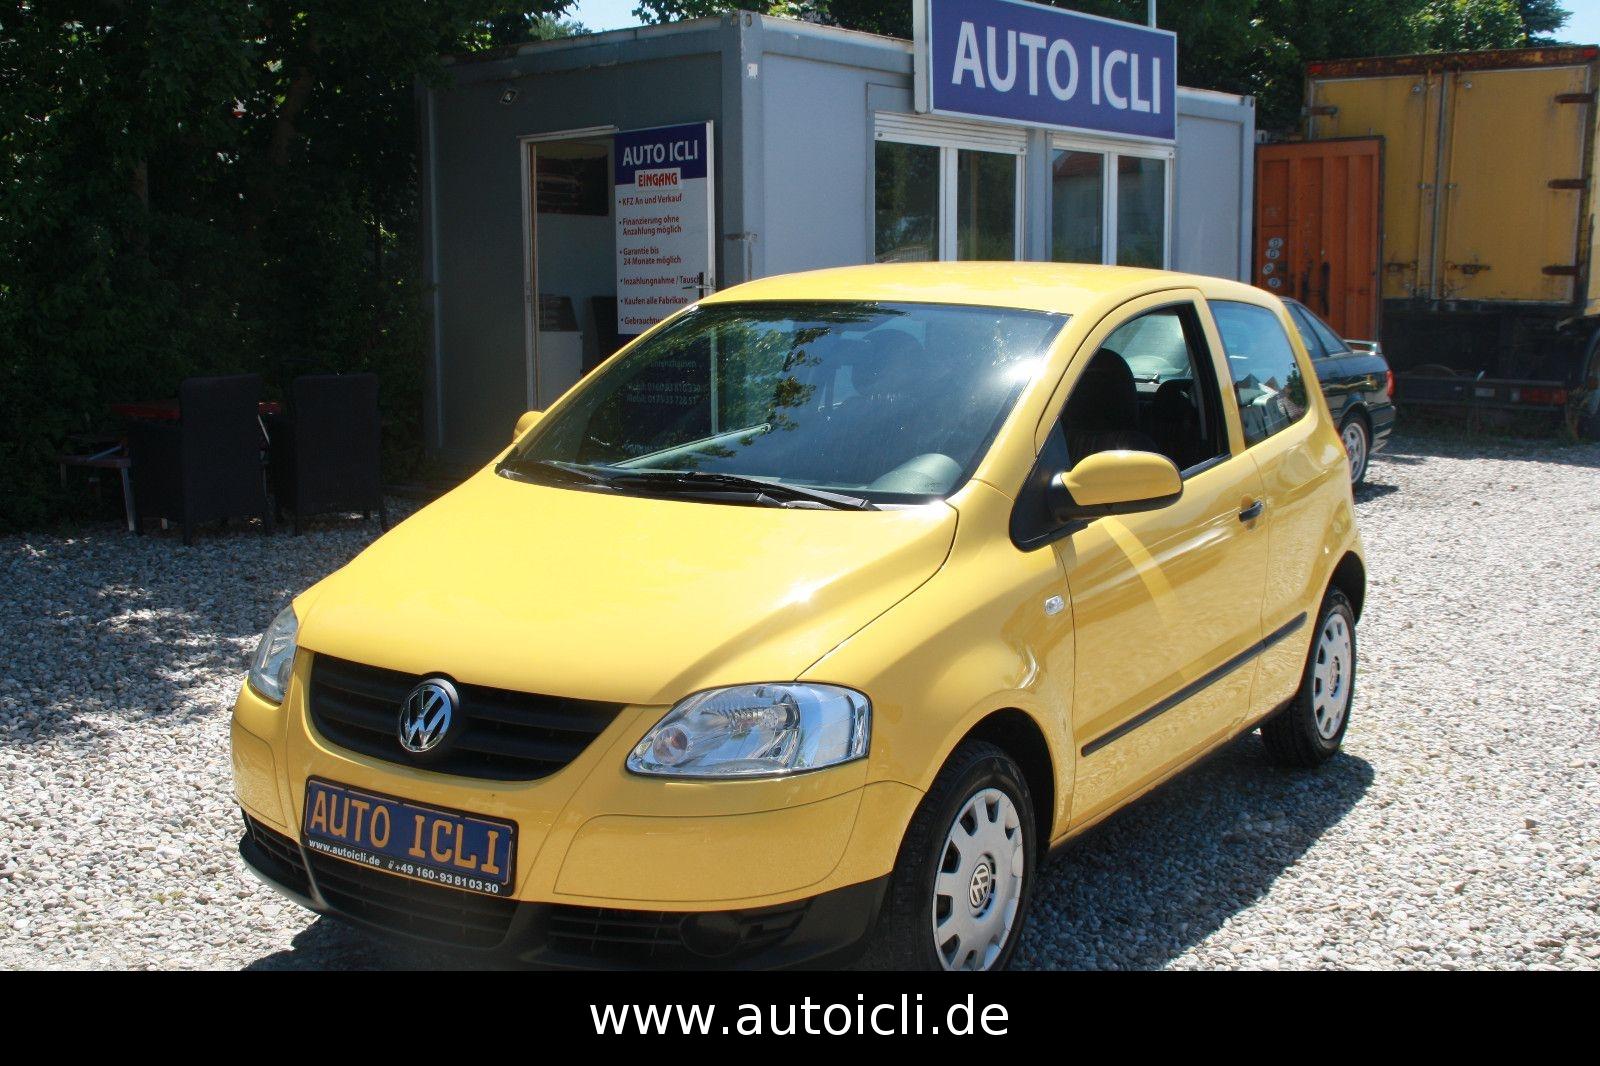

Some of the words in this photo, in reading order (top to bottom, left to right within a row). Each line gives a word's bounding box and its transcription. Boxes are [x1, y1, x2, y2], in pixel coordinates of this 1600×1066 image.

[952, 21, 1079, 101] AUTO
[1091, 46, 1161, 114] ICLI
[622, 143, 665, 166] AUTO
[669, 140, 699, 162] ICLI
[622, 197, 634, 206] KFZ
[645, 195, 657, 204] und
[657, 193, 682, 203] Verkauf
[622, 216, 663, 226] Finanzierung
[664, 214, 680, 223] ohne
[622, 226, 656, 237] Anzahlung
[656, 224, 682, 235] möglich
[623, 246, 649, 256] Garantie
[650, 245, 660, 255] bis
[623, 257, 631, 266] 24
[632, 256, 656, 265] Monate
[657, 255, 682, 266] möglich
[623, 275, 676, 287] Inzahlungnahme
[624, 296, 645, 305] Kaufen
[646, 296, 658, 305] alle
[658, 295, 688, 305] Fabrikate
[310, 790, 390, 848] AUTO
[408, 814, 500, 875] ICLI
[308, 838, 381, 867] www.autoicli.de
[395, 863, 414, 875] +49
